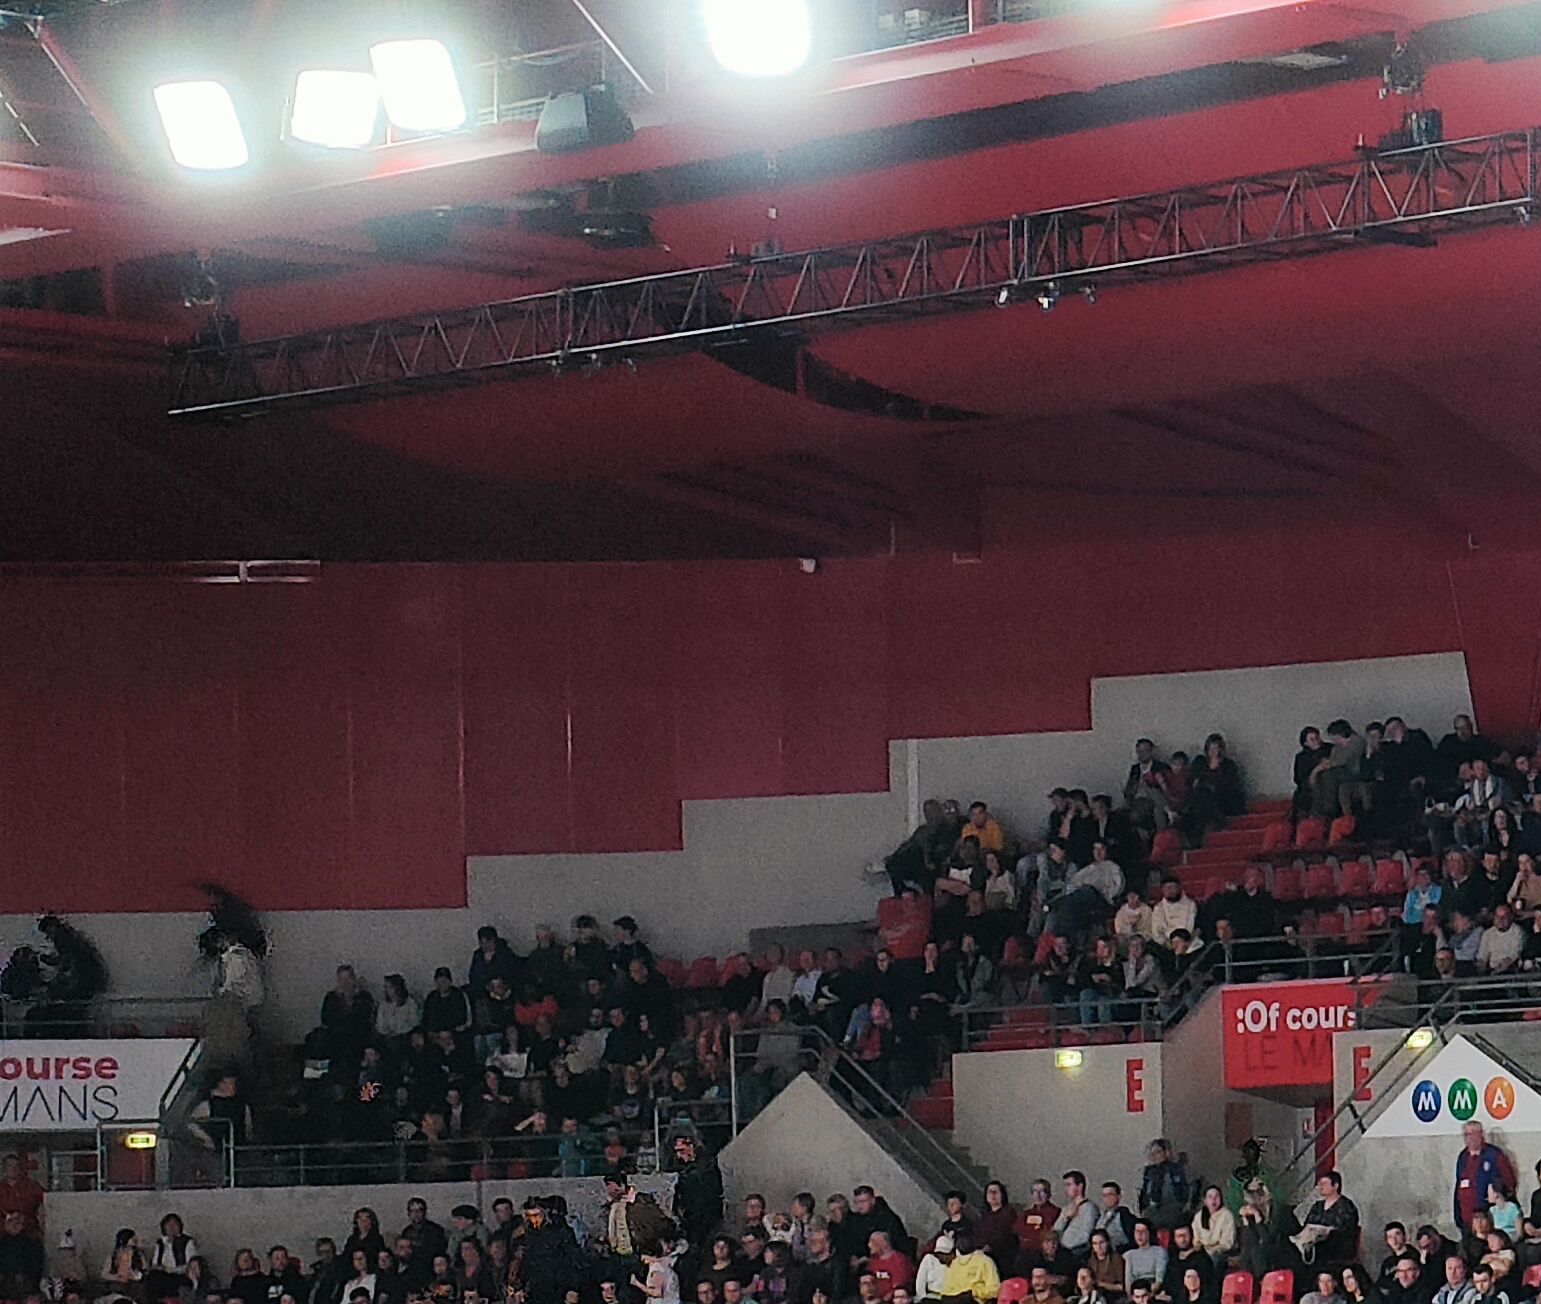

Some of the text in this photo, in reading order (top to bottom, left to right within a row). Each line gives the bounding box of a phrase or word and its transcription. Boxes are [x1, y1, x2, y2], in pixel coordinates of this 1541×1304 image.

[1127, 1058, 1145, 1113] E
[1353, 1046, 1372, 1101] E
[1415, 1083, 1511, 1117] MMA
